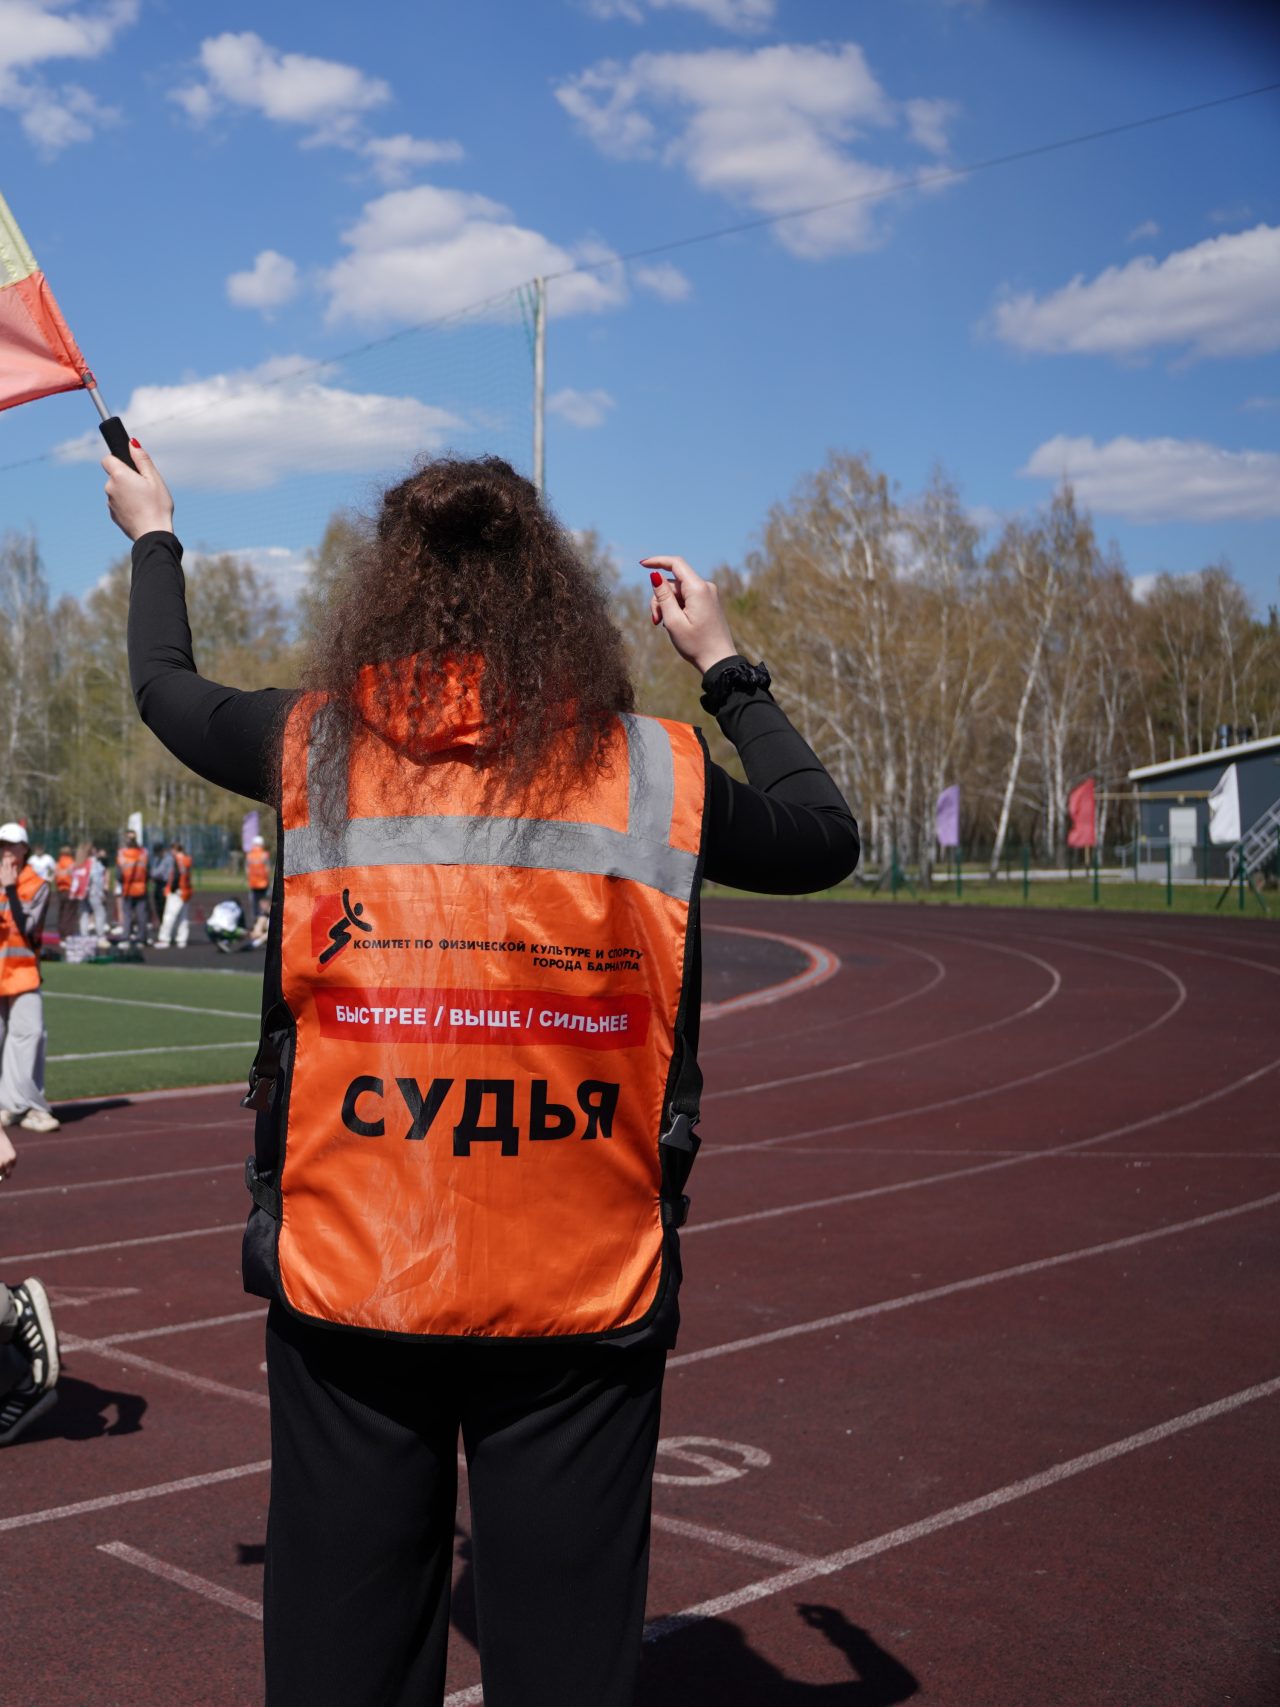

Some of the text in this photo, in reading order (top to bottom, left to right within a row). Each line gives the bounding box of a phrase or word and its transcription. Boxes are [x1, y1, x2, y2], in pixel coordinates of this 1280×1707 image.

[353, 938, 644, 960] КОМИТЕТ ПО ФИЗИЧЕСКОЙ КУЛЬТУРЕ И СПОРТУ
[533, 957, 582, 972] ГОРОДА
[335, 1005, 427, 1025] БЫСТРЕЕ
[449, 1008, 521, 1028] ВЫШЕ
[538, 1010, 628, 1033] СИЛЬНЕЕ
[340, 1075, 620, 1157] СУДЬЯ
